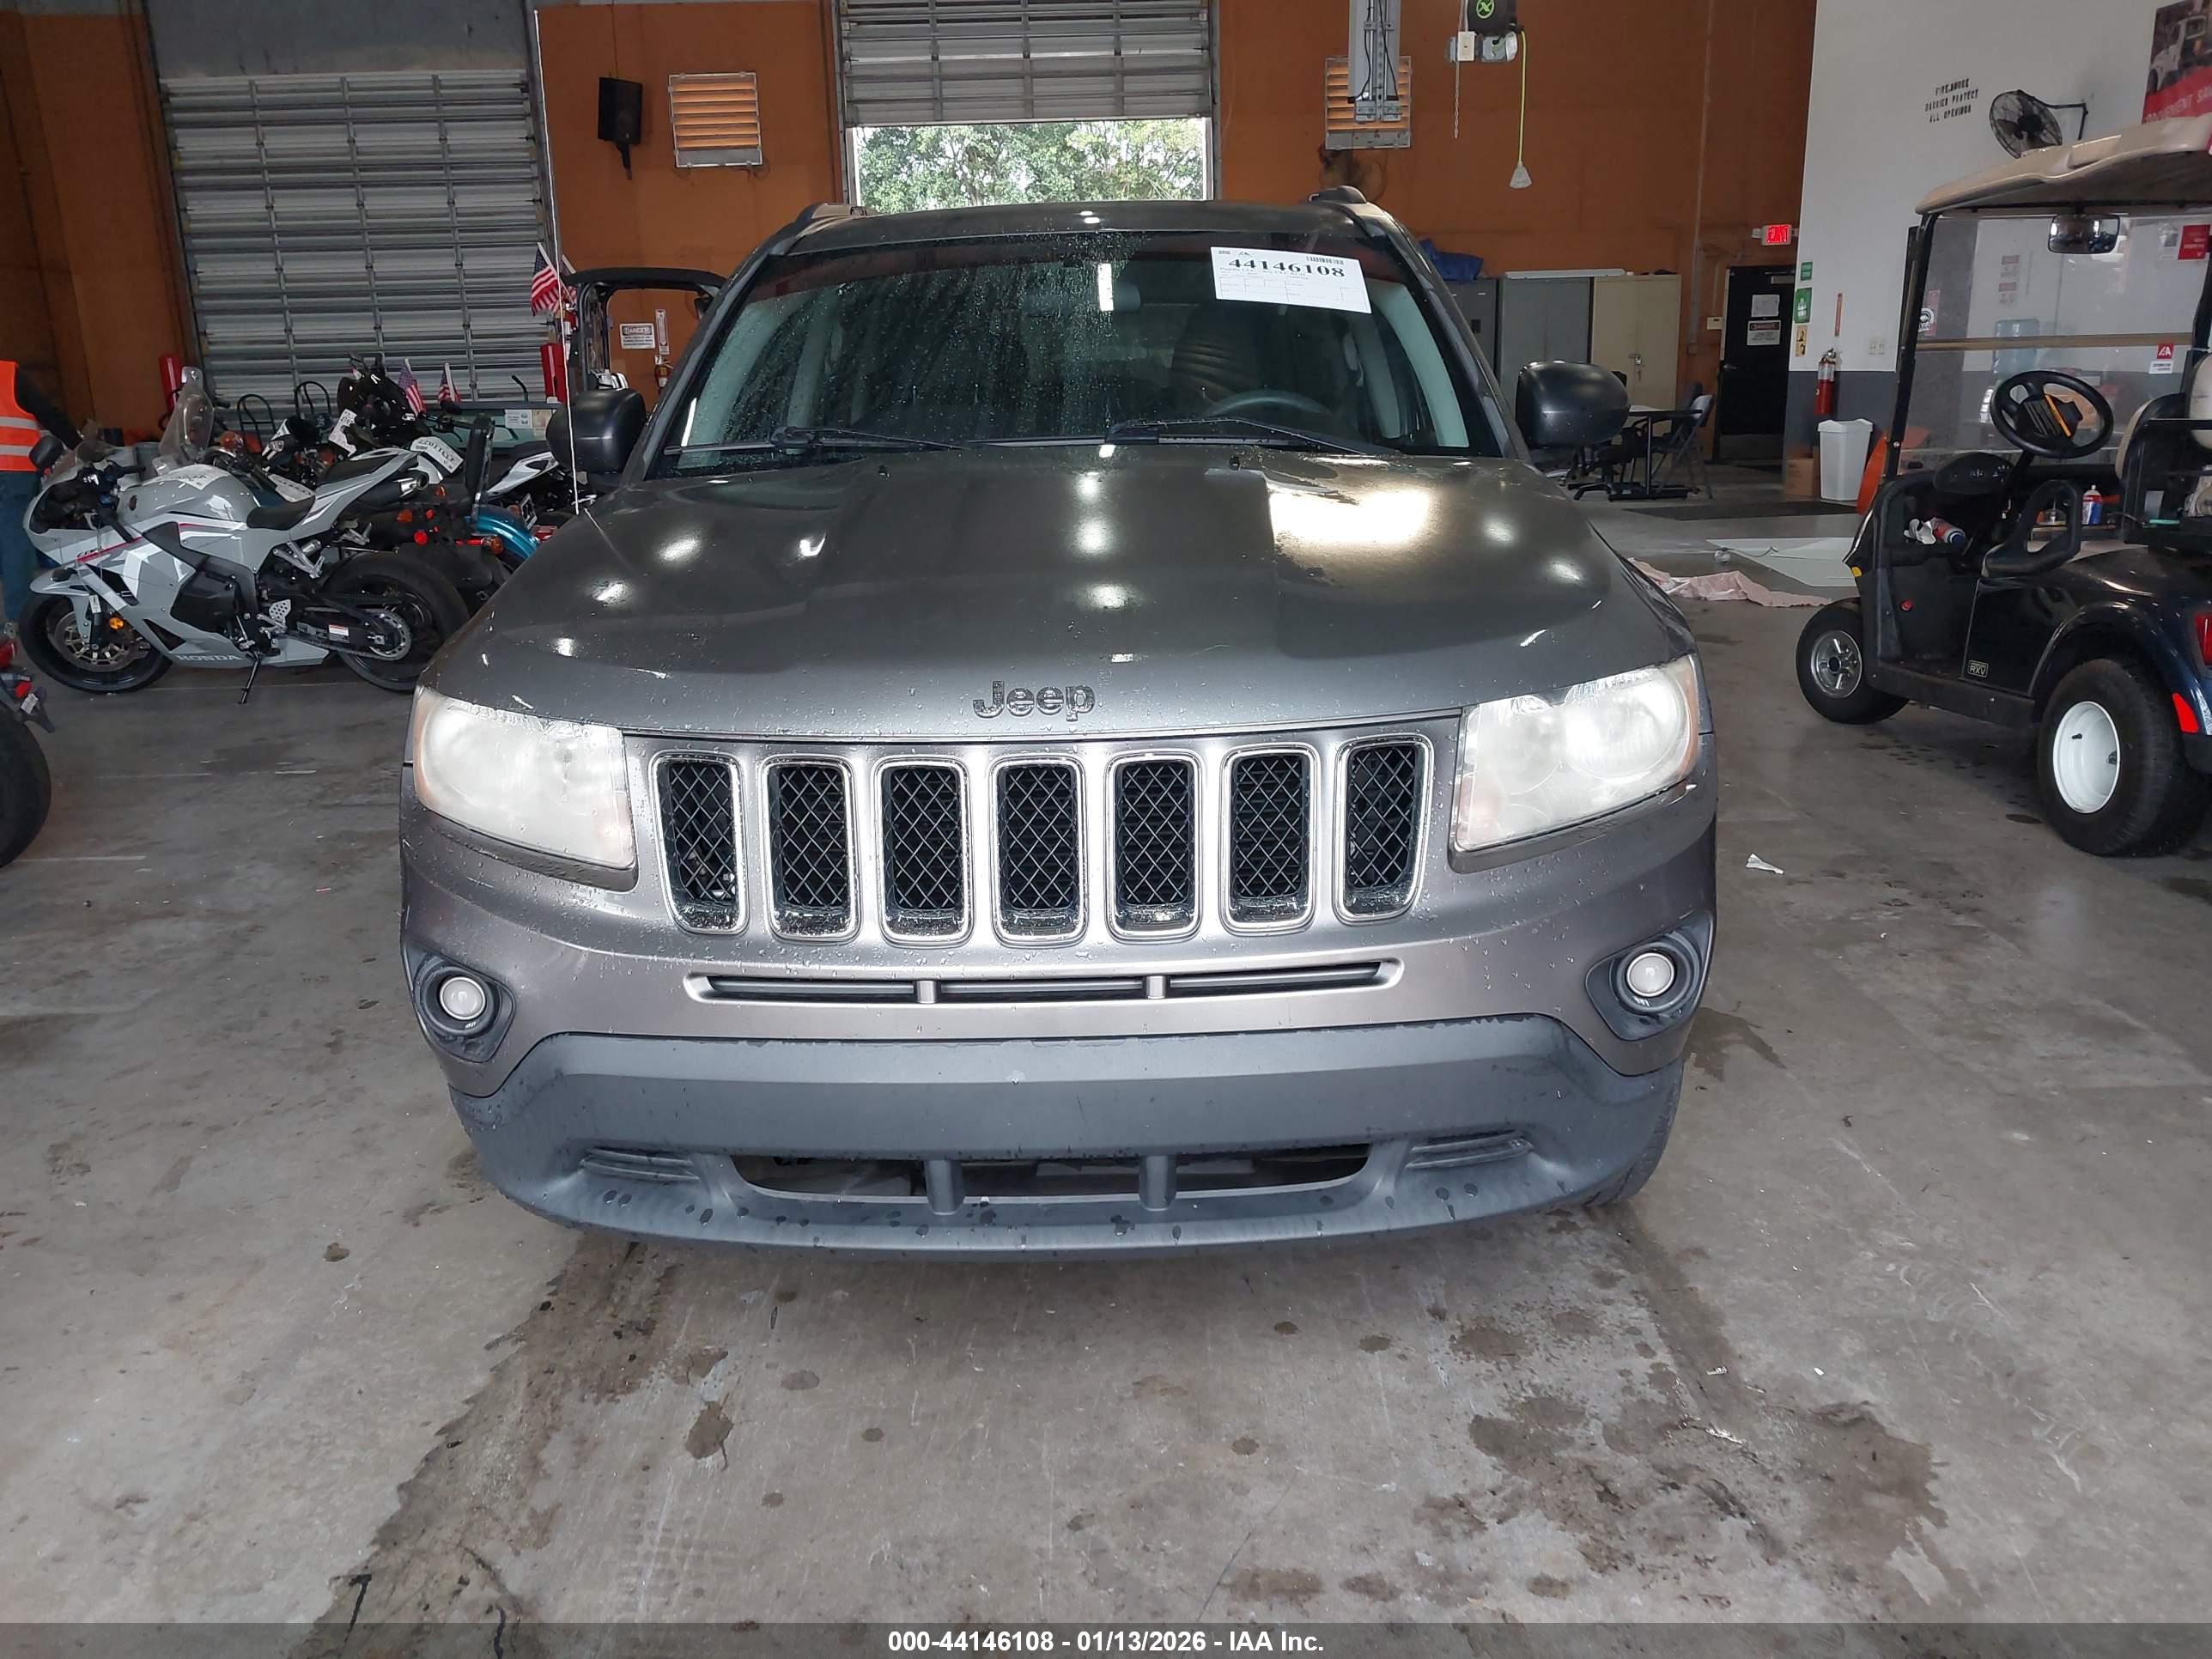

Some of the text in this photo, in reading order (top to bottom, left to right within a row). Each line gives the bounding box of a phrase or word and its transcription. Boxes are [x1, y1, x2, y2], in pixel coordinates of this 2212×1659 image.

[1229, 258, 1346, 278] 44146108
[1970, 665, 1986, 675] RXV
[972, 680, 1096, 722] Jeep
